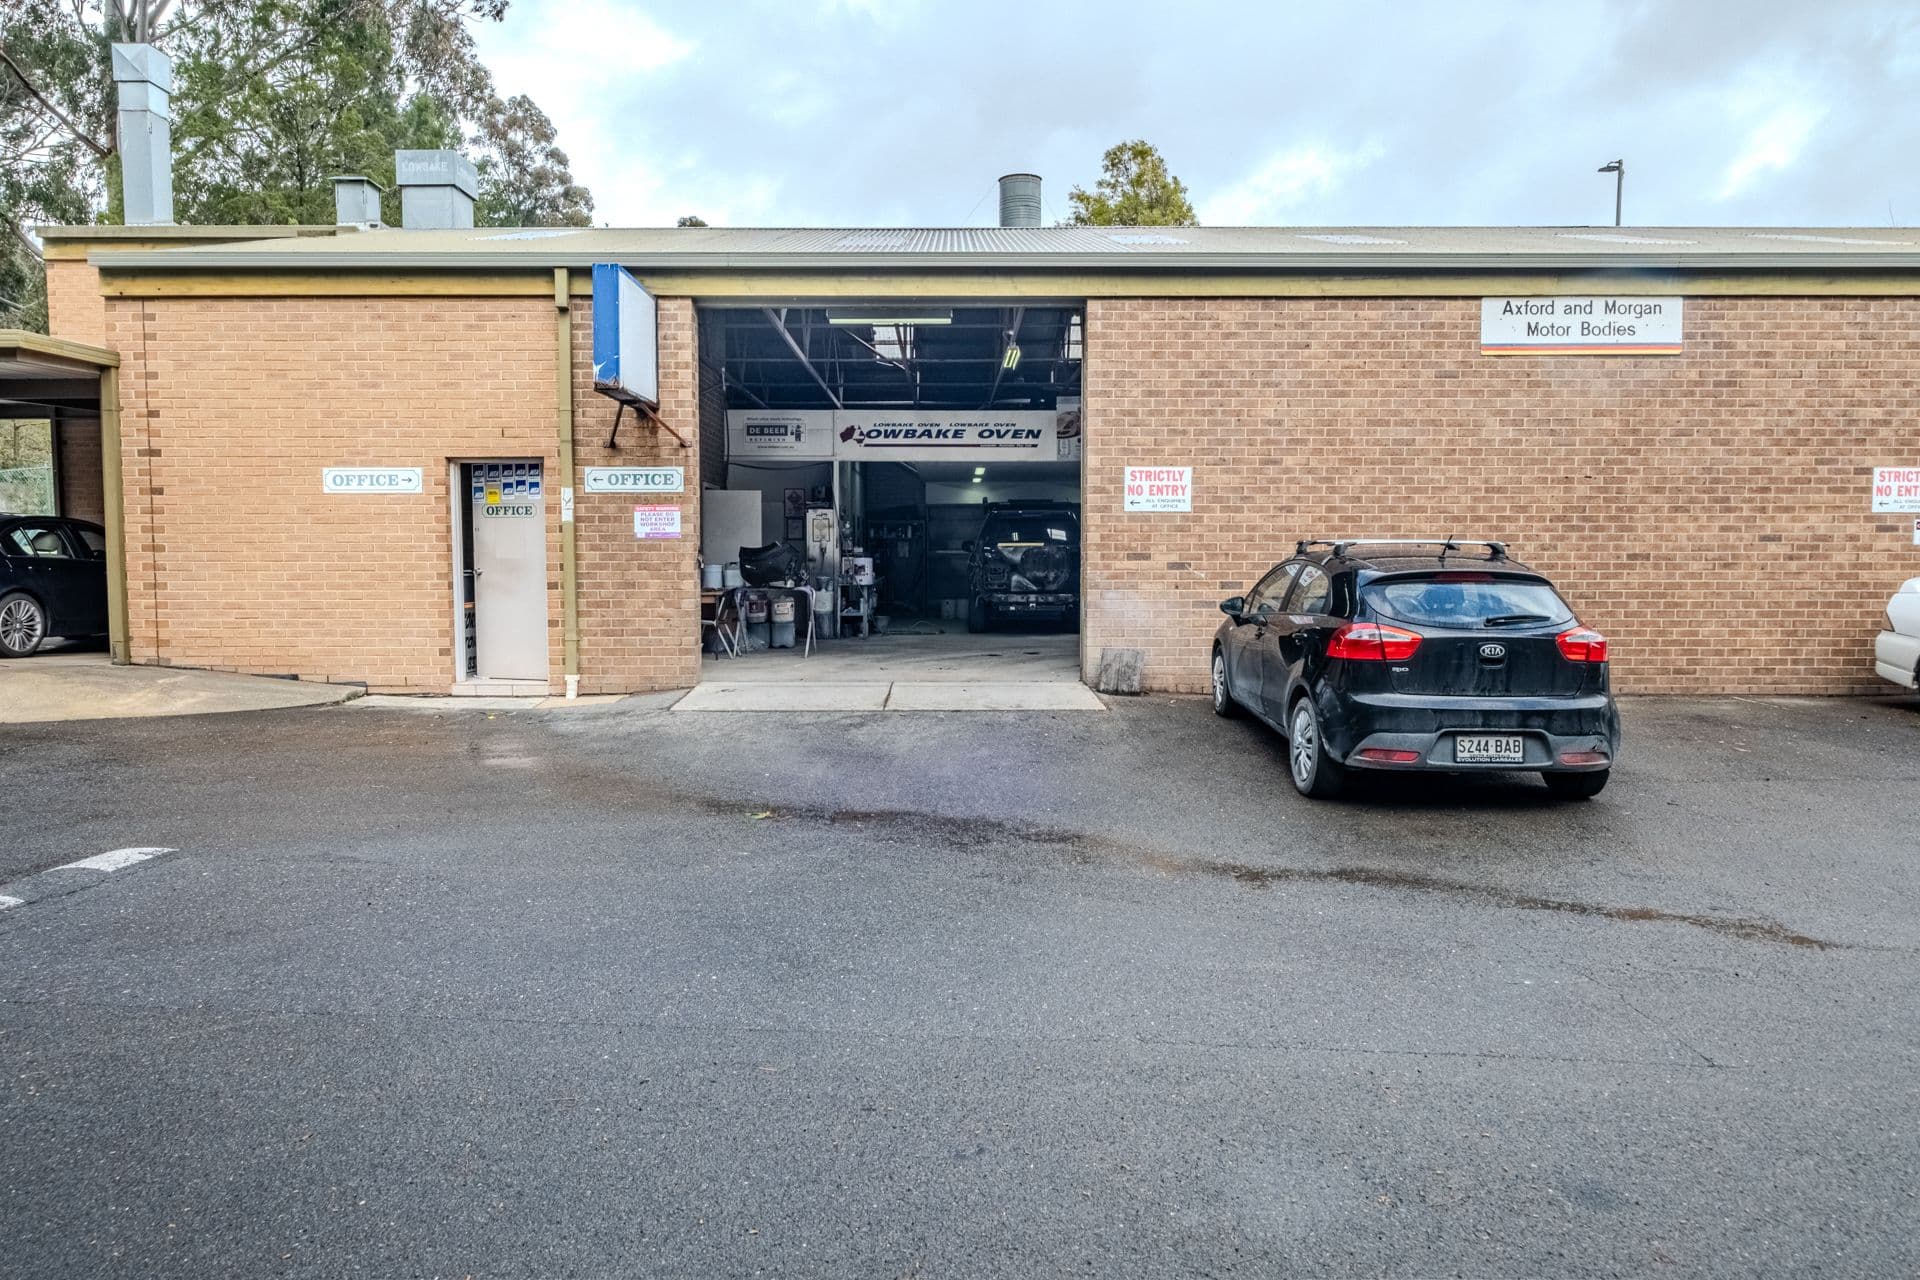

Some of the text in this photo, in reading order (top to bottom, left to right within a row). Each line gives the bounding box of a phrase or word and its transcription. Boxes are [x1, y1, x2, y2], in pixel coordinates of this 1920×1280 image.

[1502, 300, 1662, 318] Axford and Morgan
[1527, 321, 1636, 337] Motor Bodies
[977, 428, 1042, 439] OVEN
[332, 474, 399, 487] OFFICE
[607, 473, 674, 486] OFFICE
[1130, 470, 1185, 482] STRICTLY
[1127, 484, 1187, 497] NO ENTRY
[1876, 485, 1892, 497] NO
[486, 505, 533, 516] OFFICE
[1484, 647, 1501, 656] KIA
